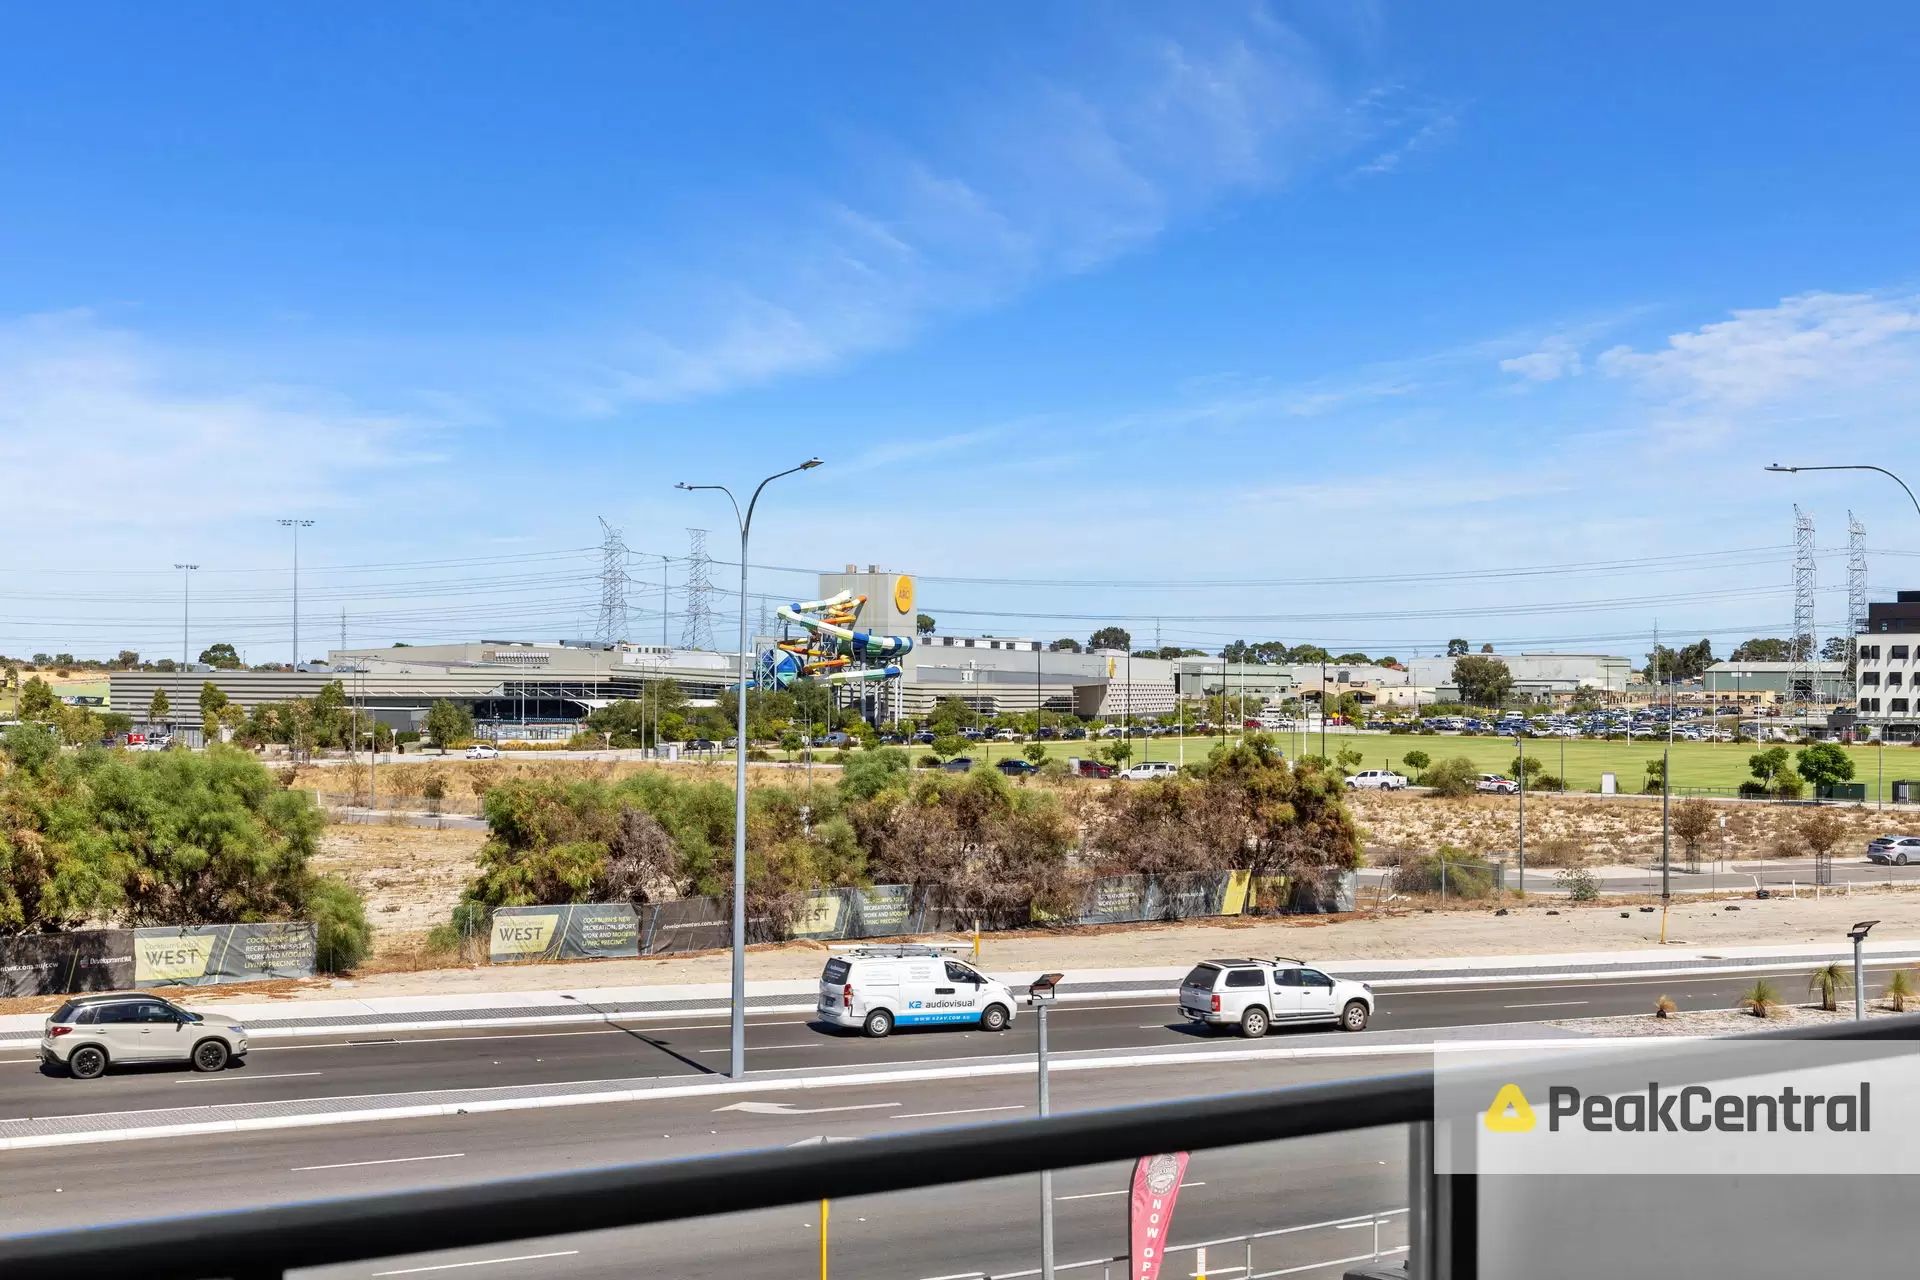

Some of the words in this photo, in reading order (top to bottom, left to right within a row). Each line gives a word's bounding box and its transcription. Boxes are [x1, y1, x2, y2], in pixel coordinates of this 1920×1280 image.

[499, 926, 543, 941] WEST
[145, 948, 198, 966] WEST
[908, 1000, 923, 1009] K2
[925, 998, 975, 1009] audiovisual
[1146, 1199, 1162, 1239] NOW
